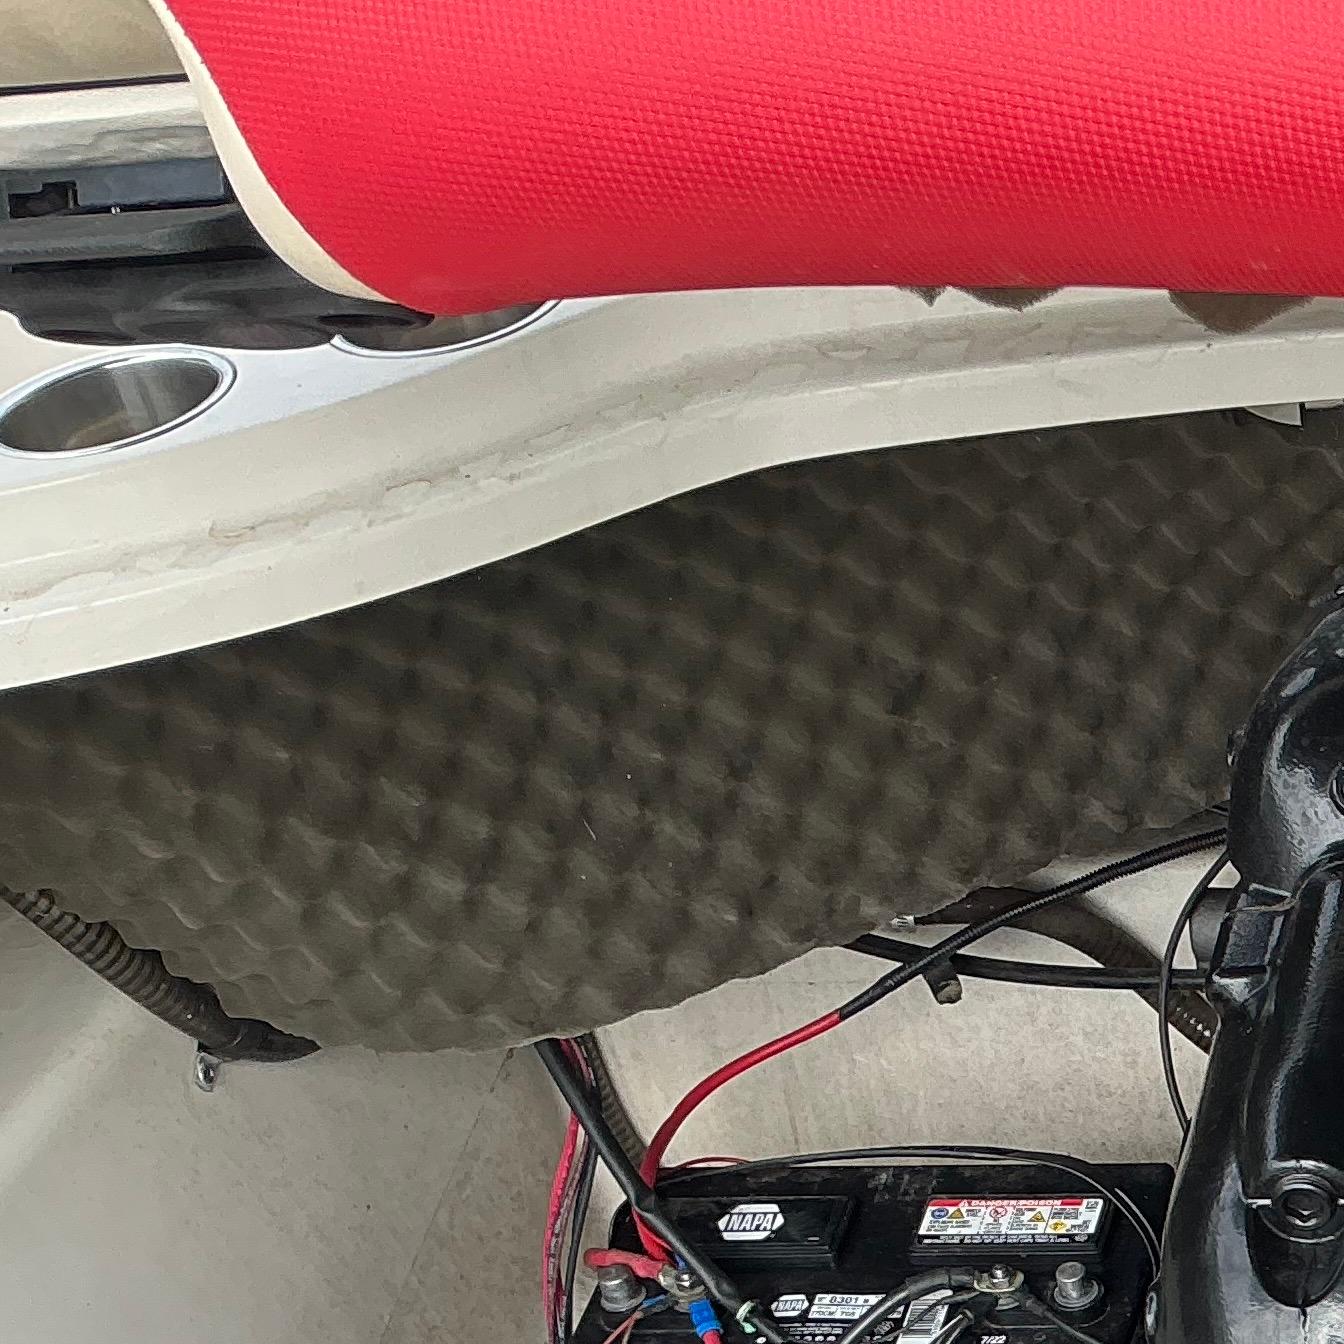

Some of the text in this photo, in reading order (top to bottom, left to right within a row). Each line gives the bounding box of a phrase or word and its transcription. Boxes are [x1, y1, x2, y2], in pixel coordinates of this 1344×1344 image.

[726, 1213, 775, 1231] NAPA
[776, 1299, 805, 1312] NAPA
[980, 1335, 1006, 1344] 7/22
